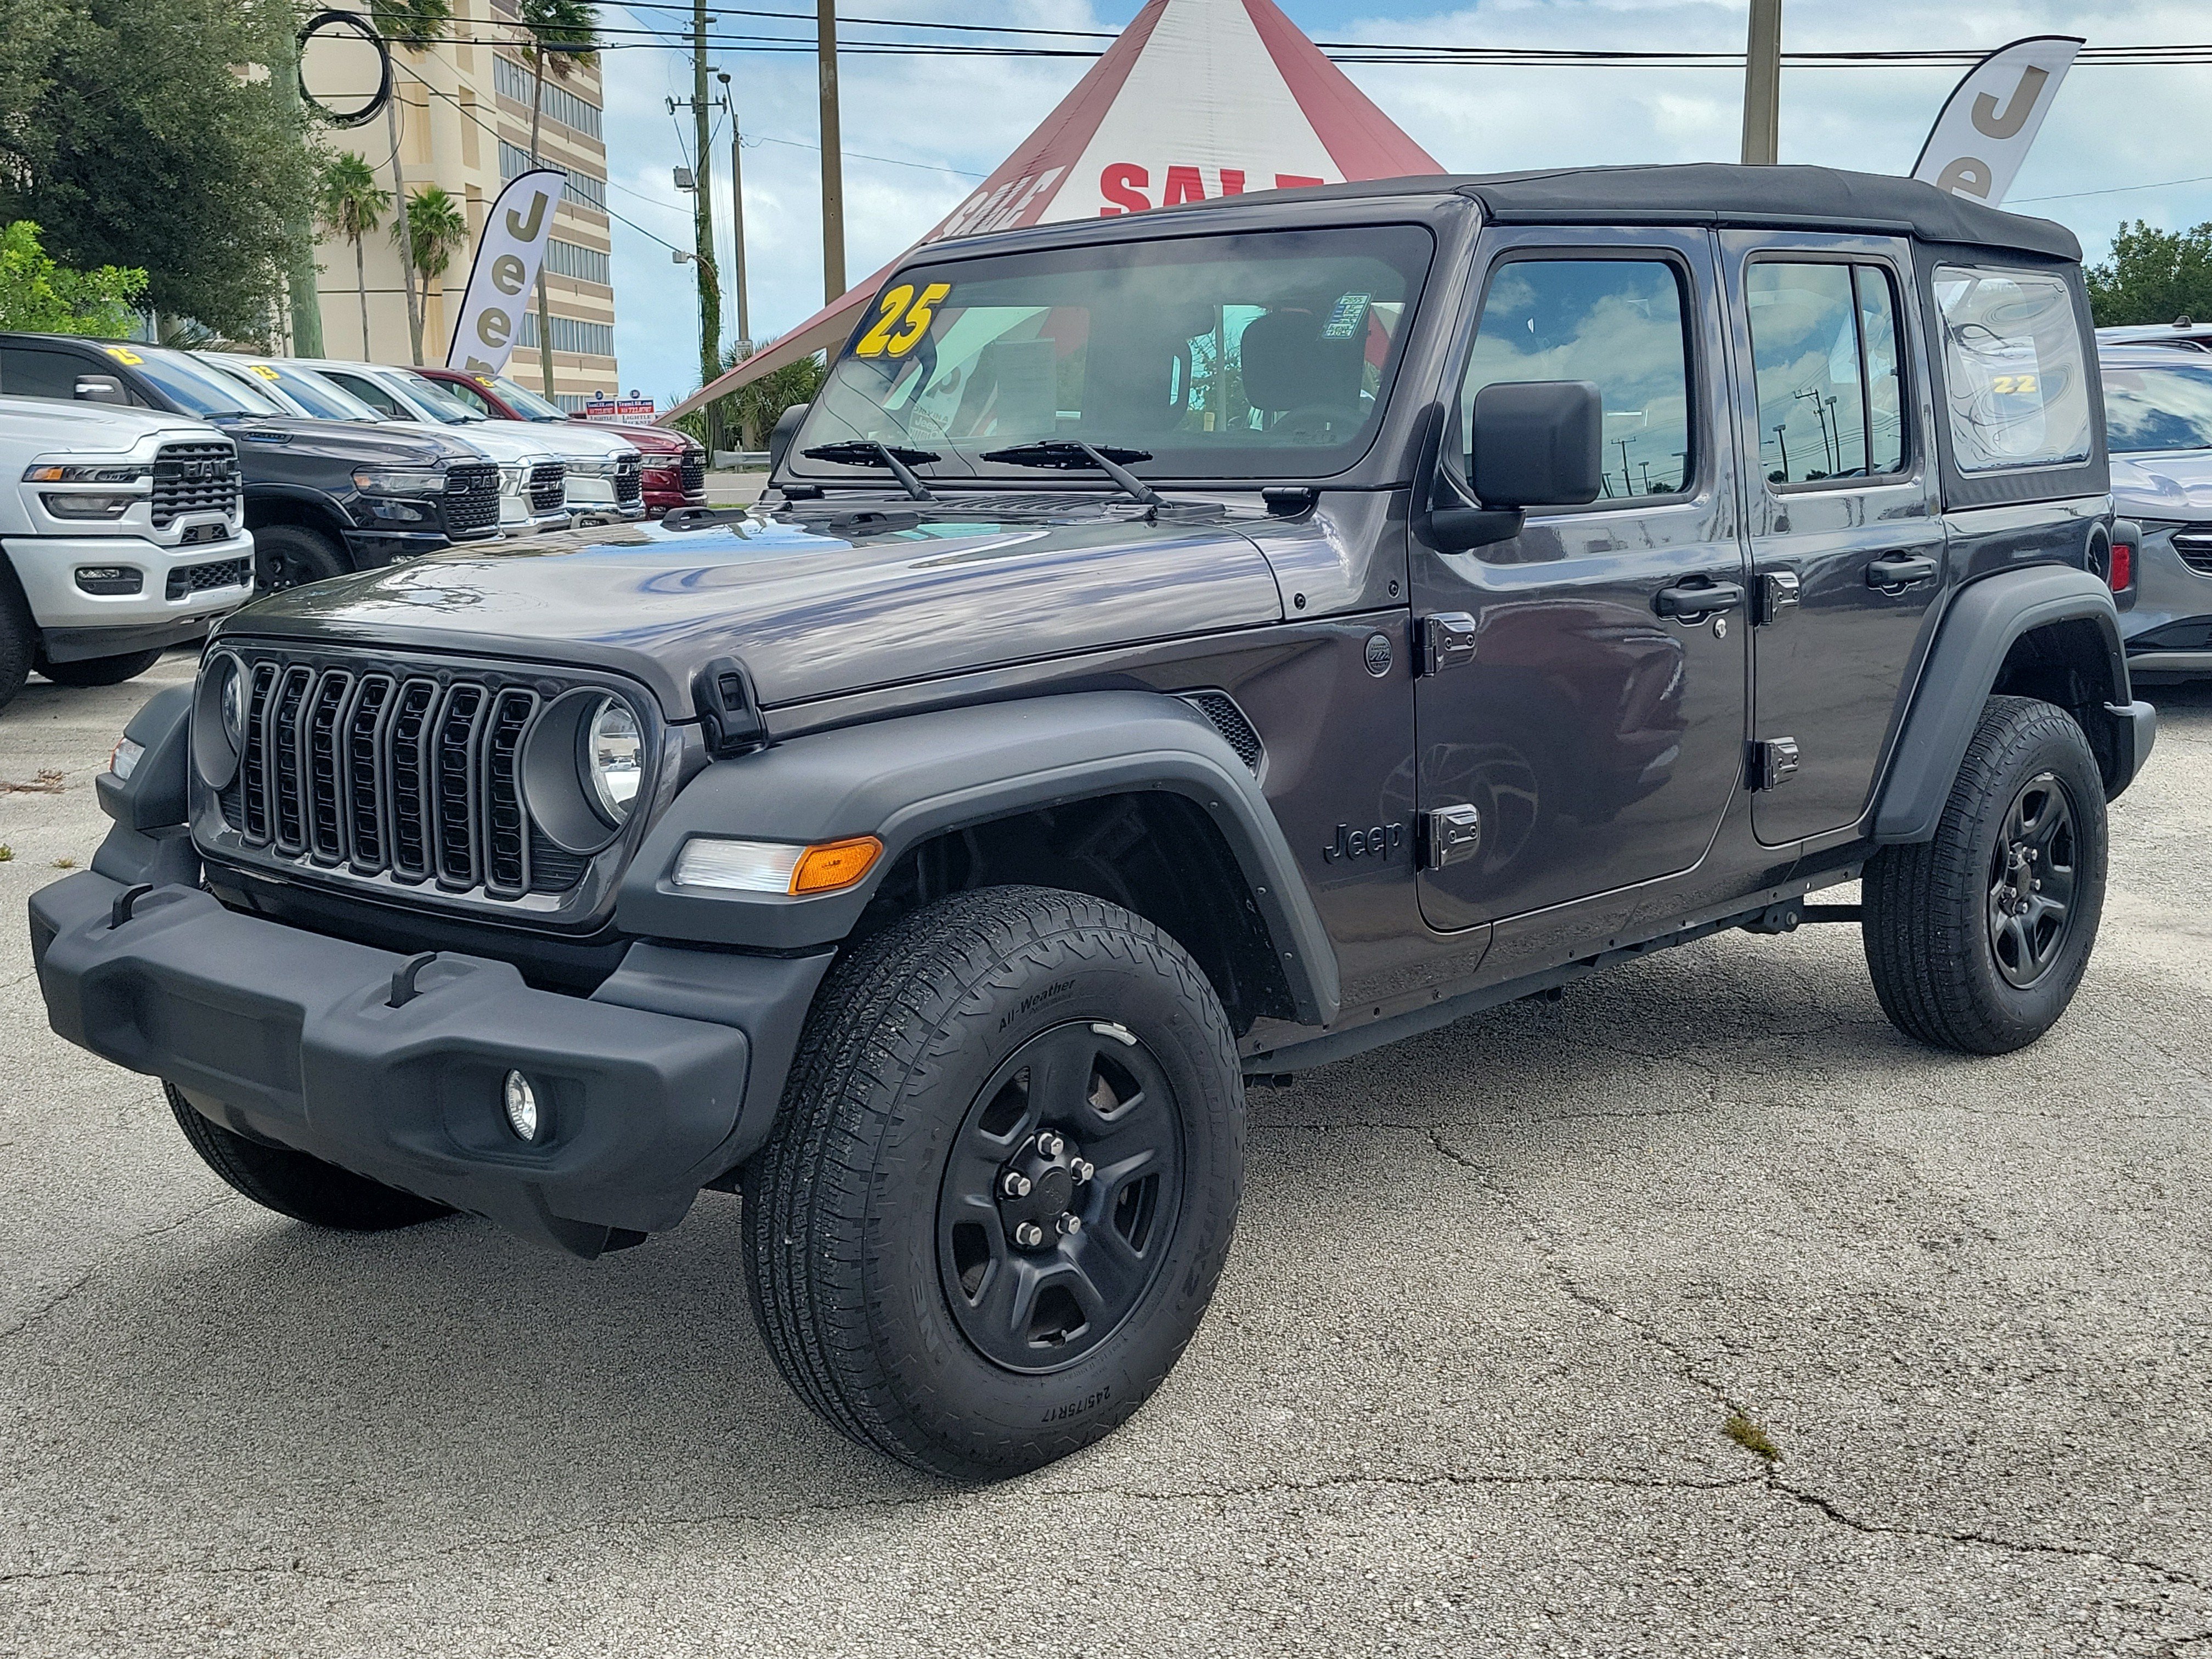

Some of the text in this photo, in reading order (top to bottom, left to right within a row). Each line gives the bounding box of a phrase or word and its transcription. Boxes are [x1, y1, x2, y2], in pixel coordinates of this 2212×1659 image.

[1100, 162, 1324, 217] SA
[856, 283, 951, 358] 25
[1993, 376, 2036, 393] 22
[915, 416, 939, 430] Jeep
[1323, 822, 1403, 865] Jeep
[998, 979, 1076, 1034] All-Weather
[1041, 1385, 1110, 1423] 245/75R17
